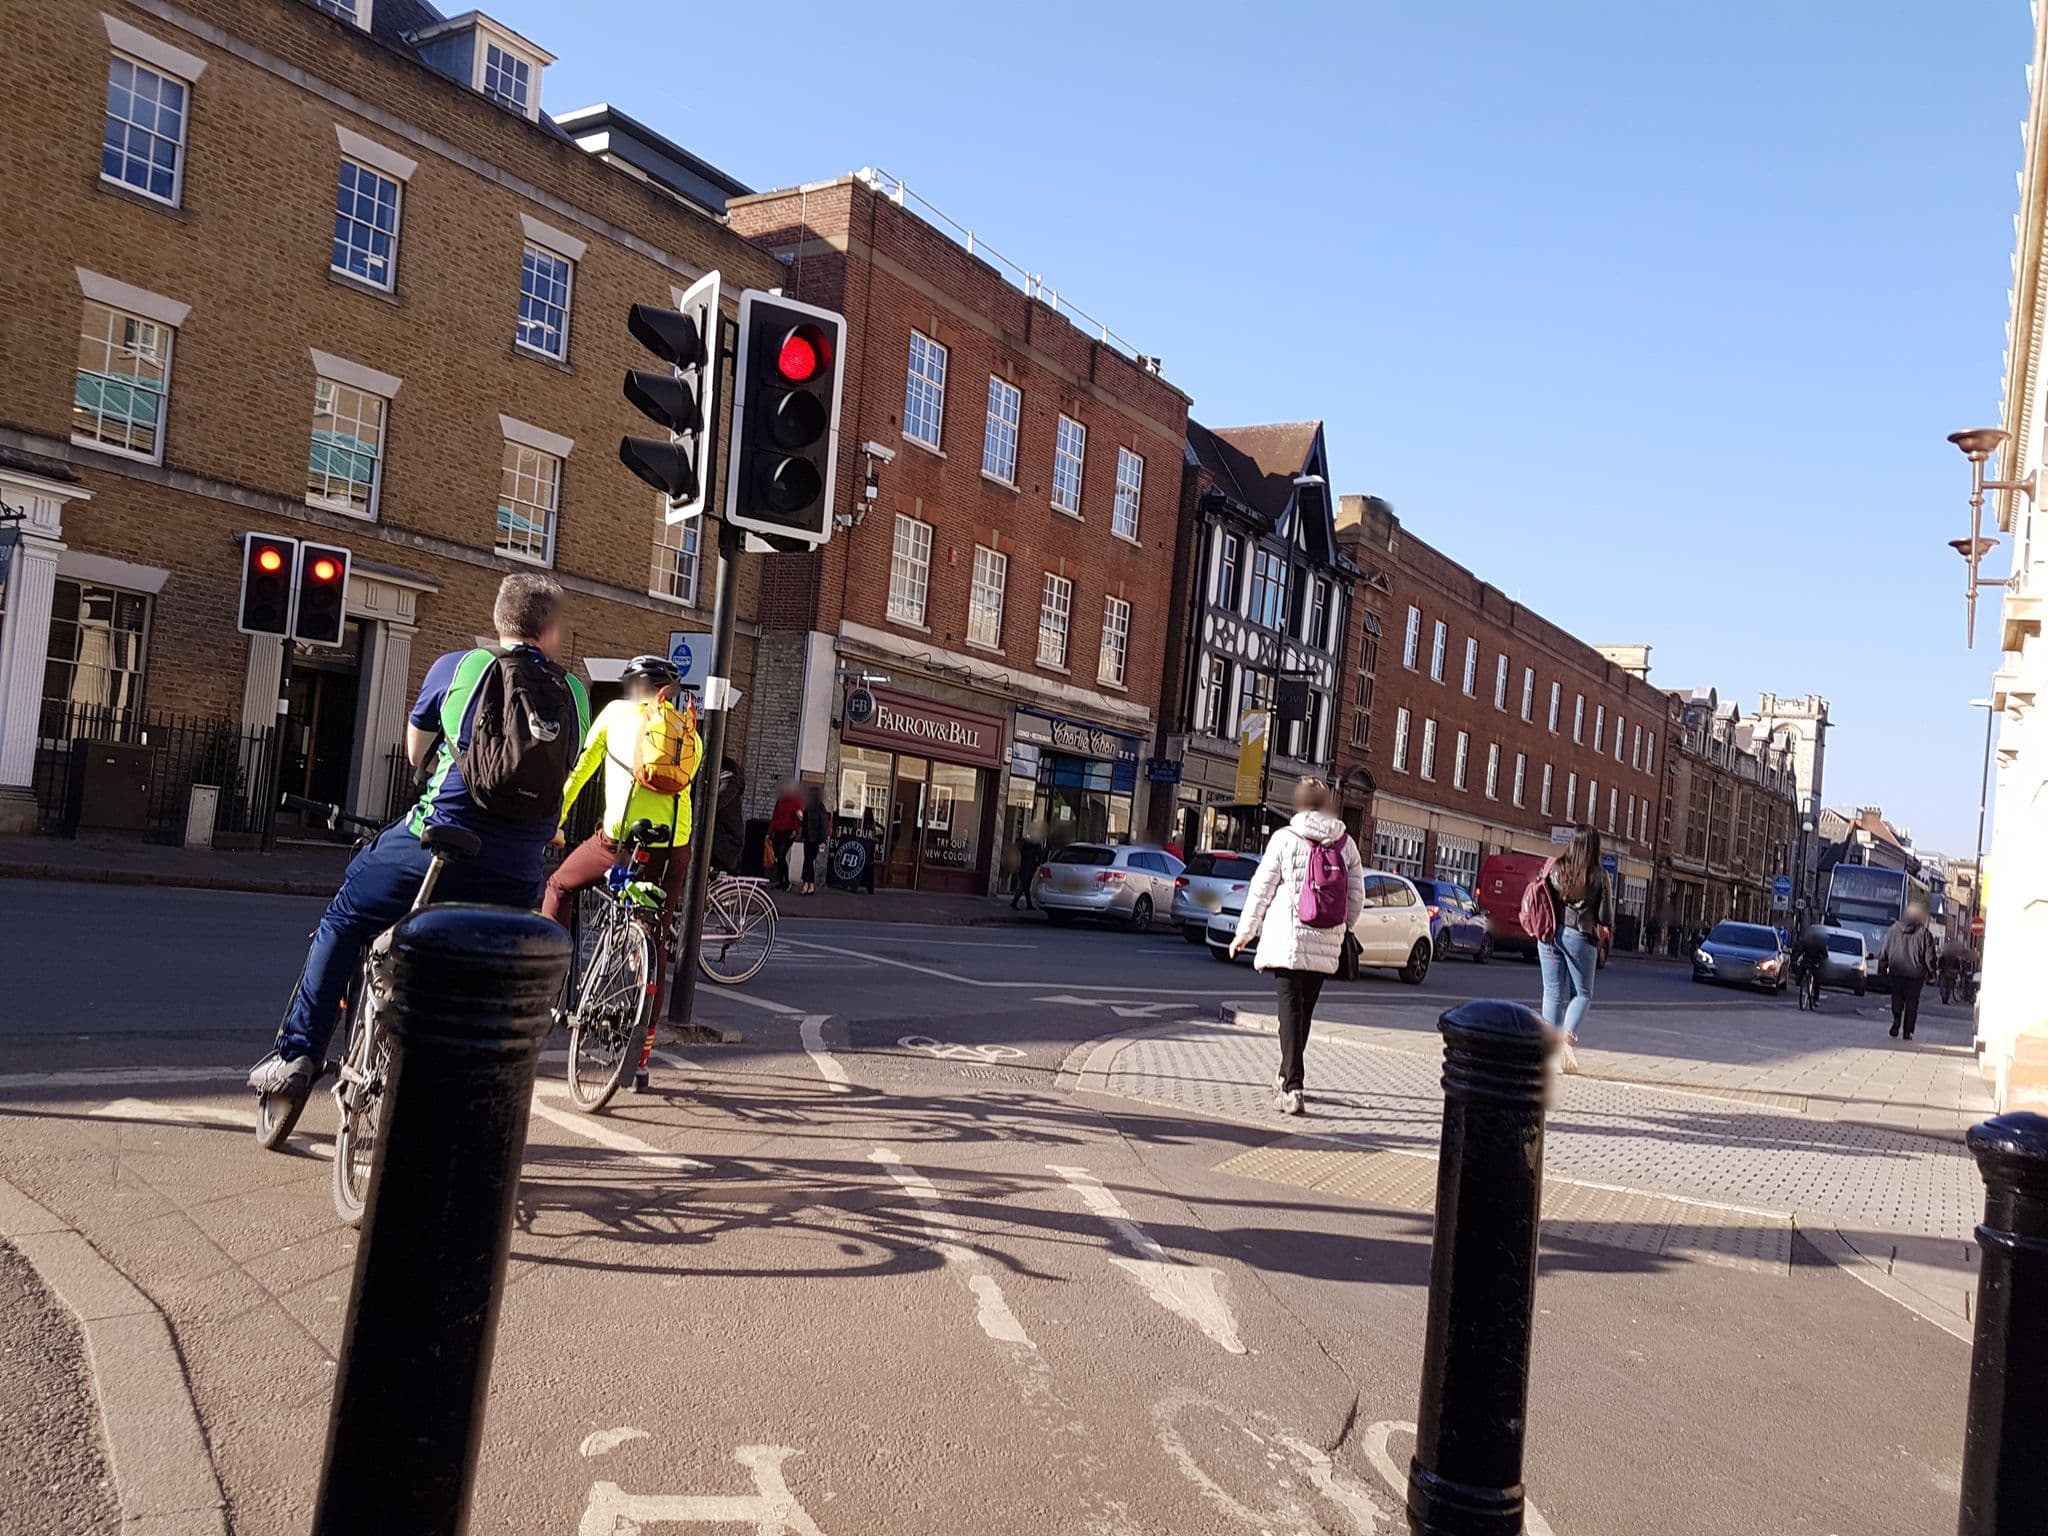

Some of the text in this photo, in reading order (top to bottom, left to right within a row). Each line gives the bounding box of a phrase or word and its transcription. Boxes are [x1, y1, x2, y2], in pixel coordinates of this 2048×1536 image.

[1053, 719, 1116, 755] Charlie Chan
[936, 837, 967, 849] TRY OUR
[925, 850, 976, 862] NEW COLOURS
